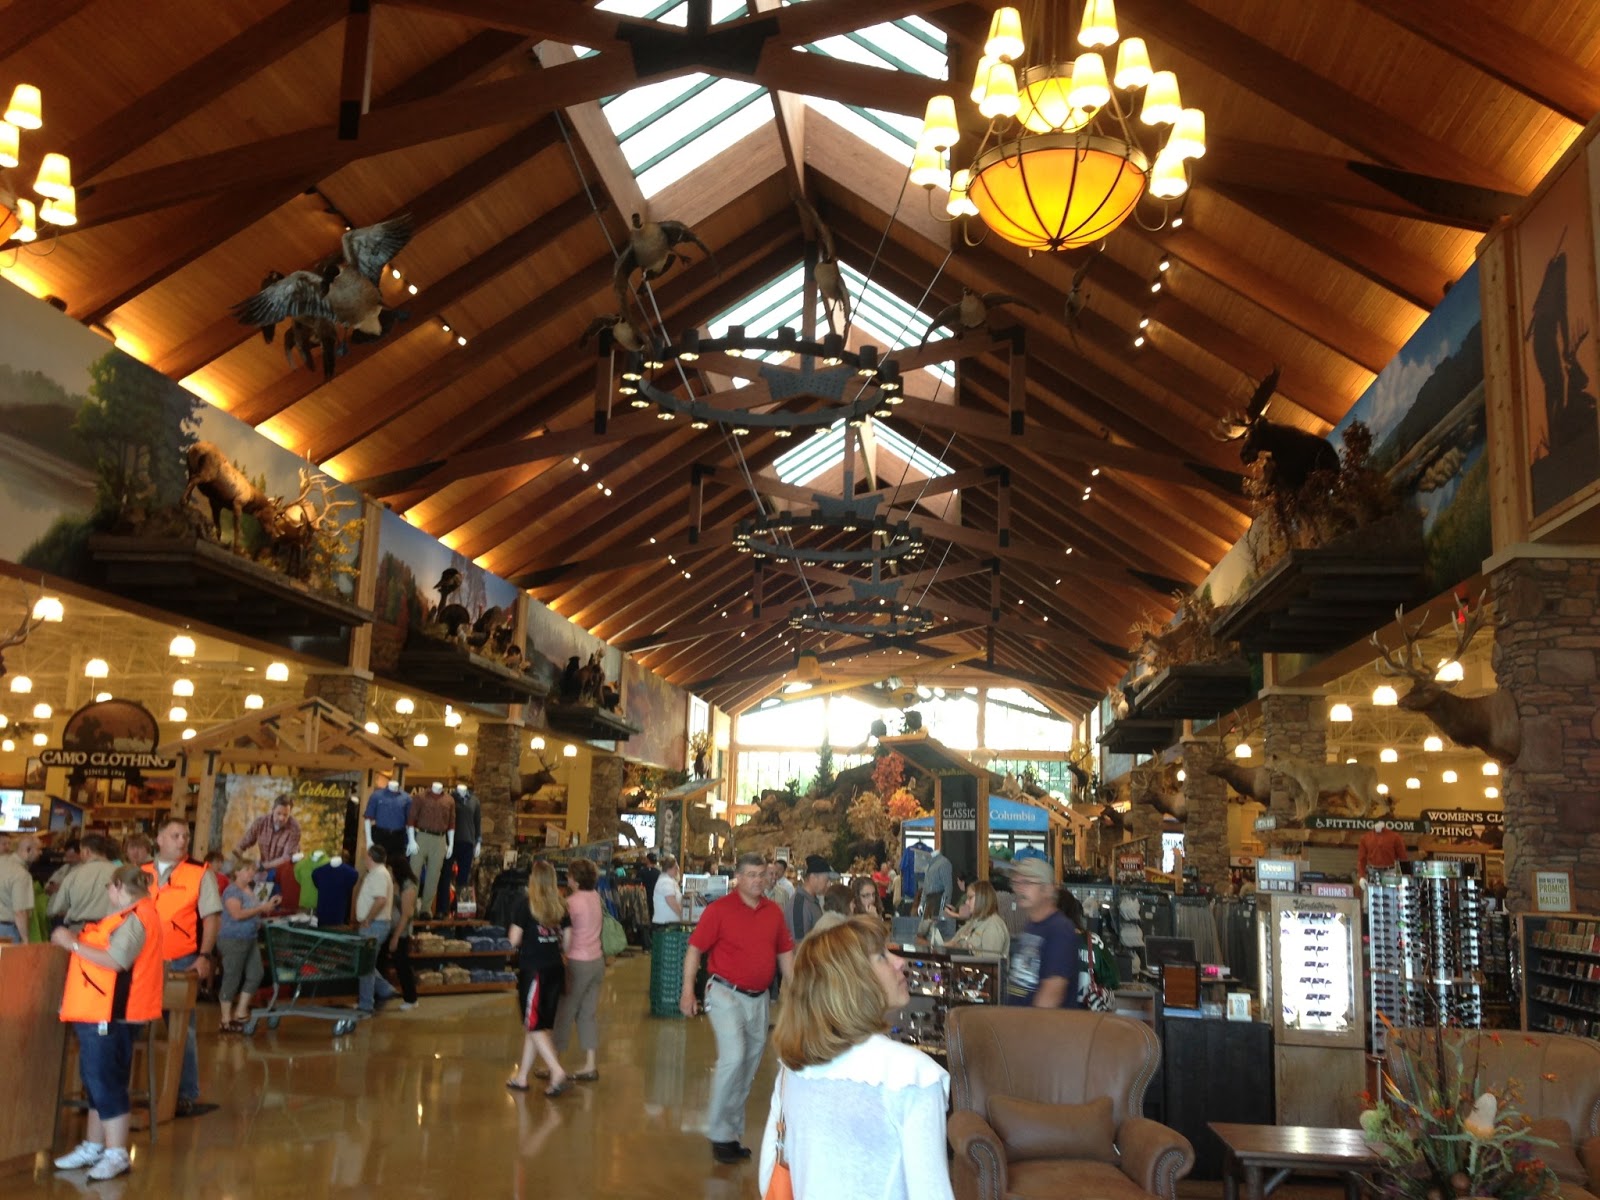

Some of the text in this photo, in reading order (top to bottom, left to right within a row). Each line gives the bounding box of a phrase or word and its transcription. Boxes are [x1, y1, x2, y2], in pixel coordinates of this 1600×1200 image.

[41, 751, 170, 768] CAMO CLOTHING
[83, 769, 108, 777] SINCE
[942, 808, 977, 818] CLASSIC
[989, 810, 1036, 822] Columbia
[1427, 811, 1484, 823] WOMEN'S
[1325, 818, 1415, 832] FITTING OOM
[1317, 886, 1347, 897] CHUMS
[1539, 884, 1568, 893] PROMISE
[1539, 896, 1560, 904] MATCH
